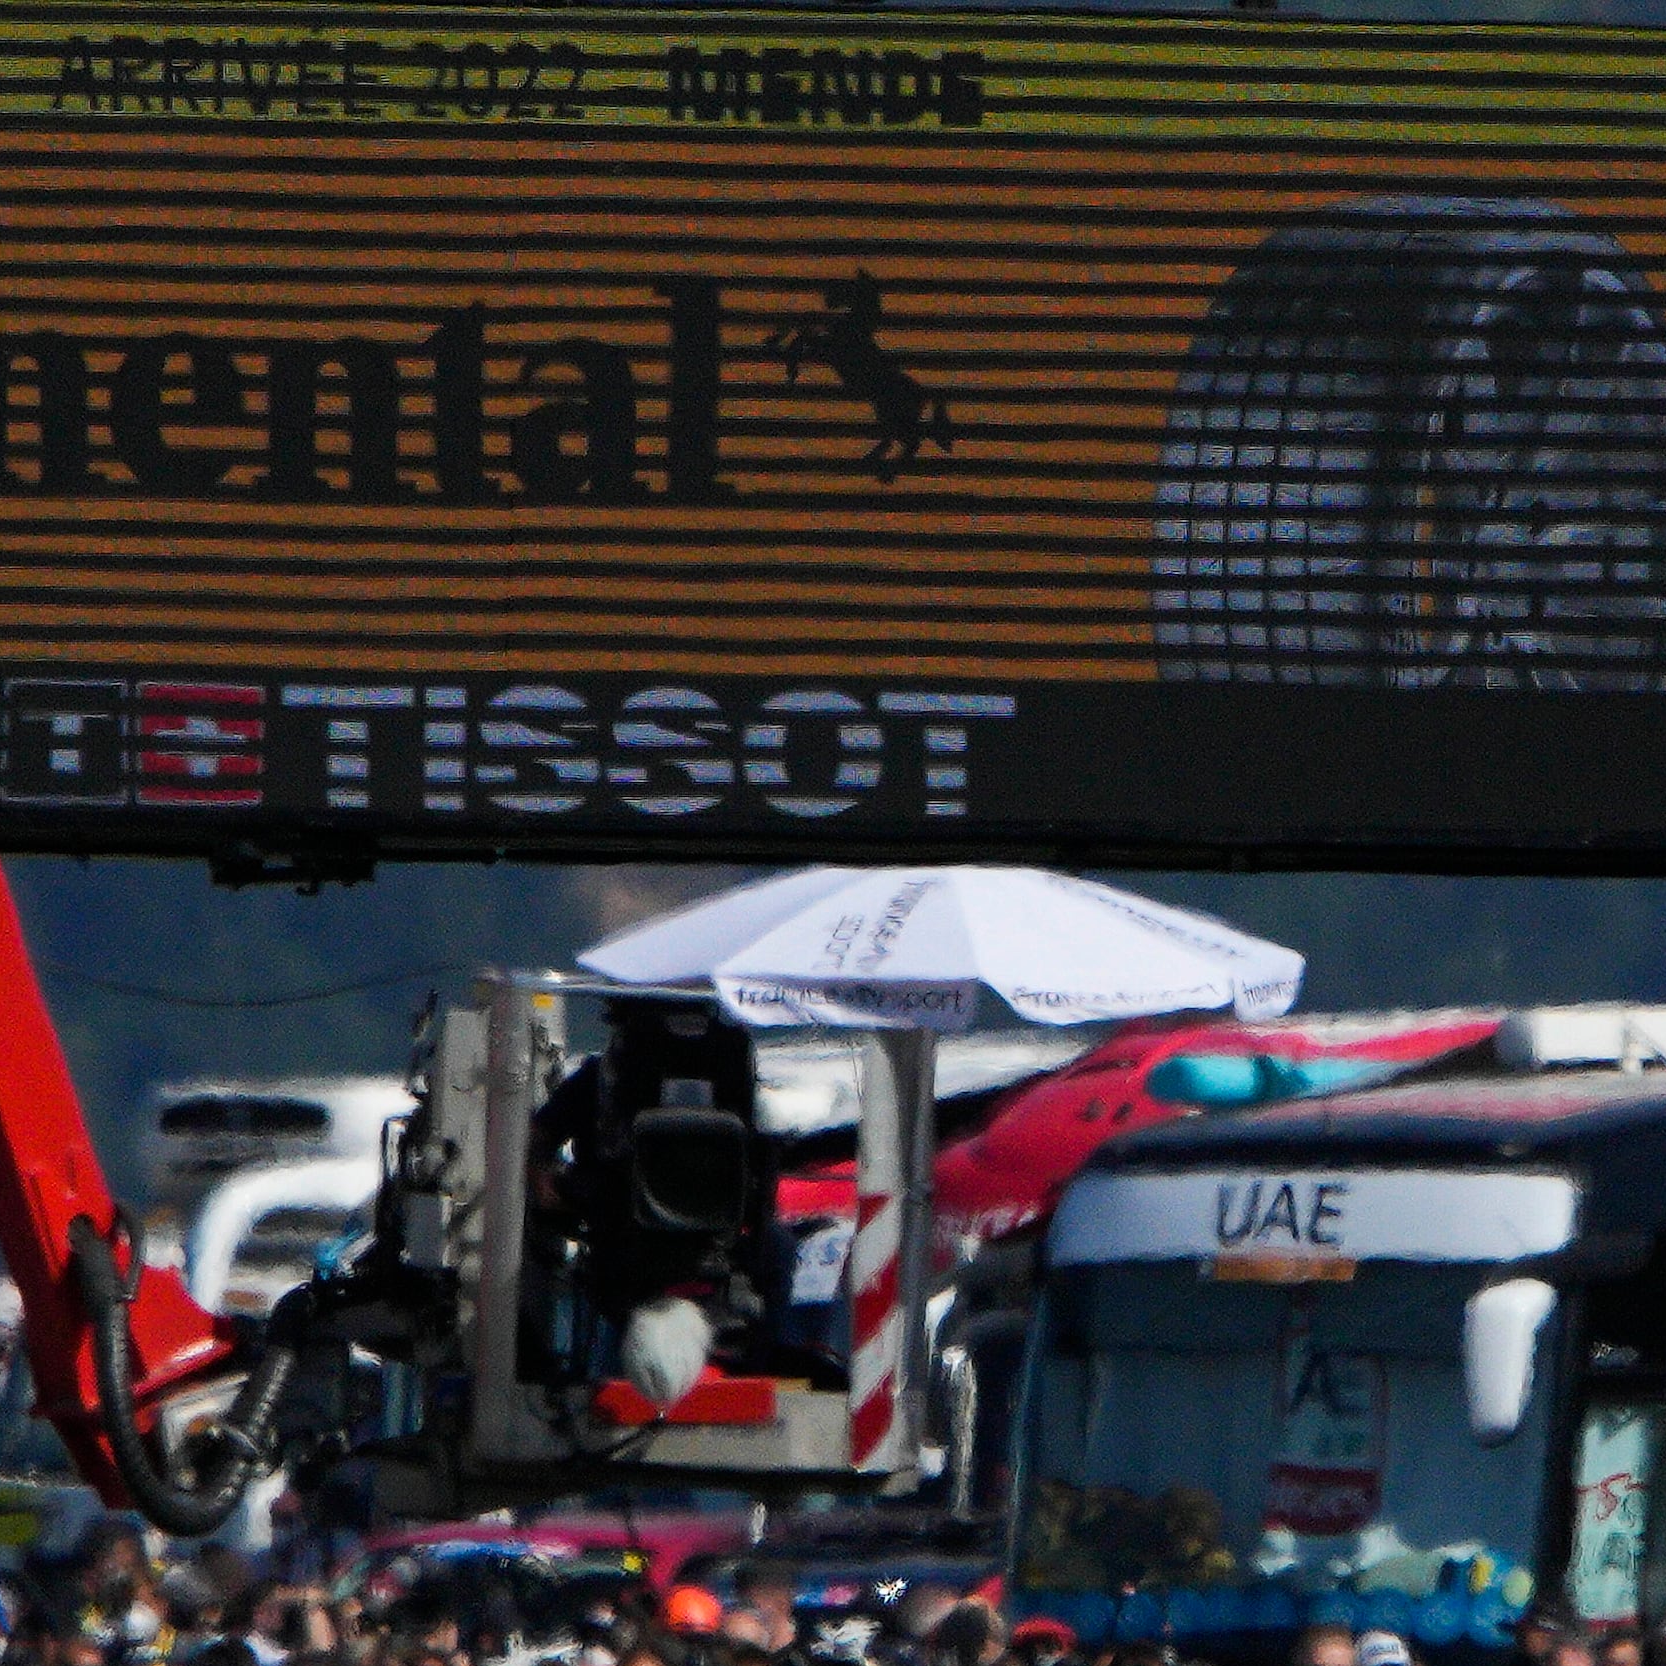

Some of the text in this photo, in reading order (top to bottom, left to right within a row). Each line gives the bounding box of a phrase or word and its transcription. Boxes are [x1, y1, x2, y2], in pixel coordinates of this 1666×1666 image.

[415, 43, 588, 119] 2022
[668, 46, 984, 127] MENDE
[281, 684, 1017, 819] TISSOT
[1215, 1181, 1350, 1248] UAE
